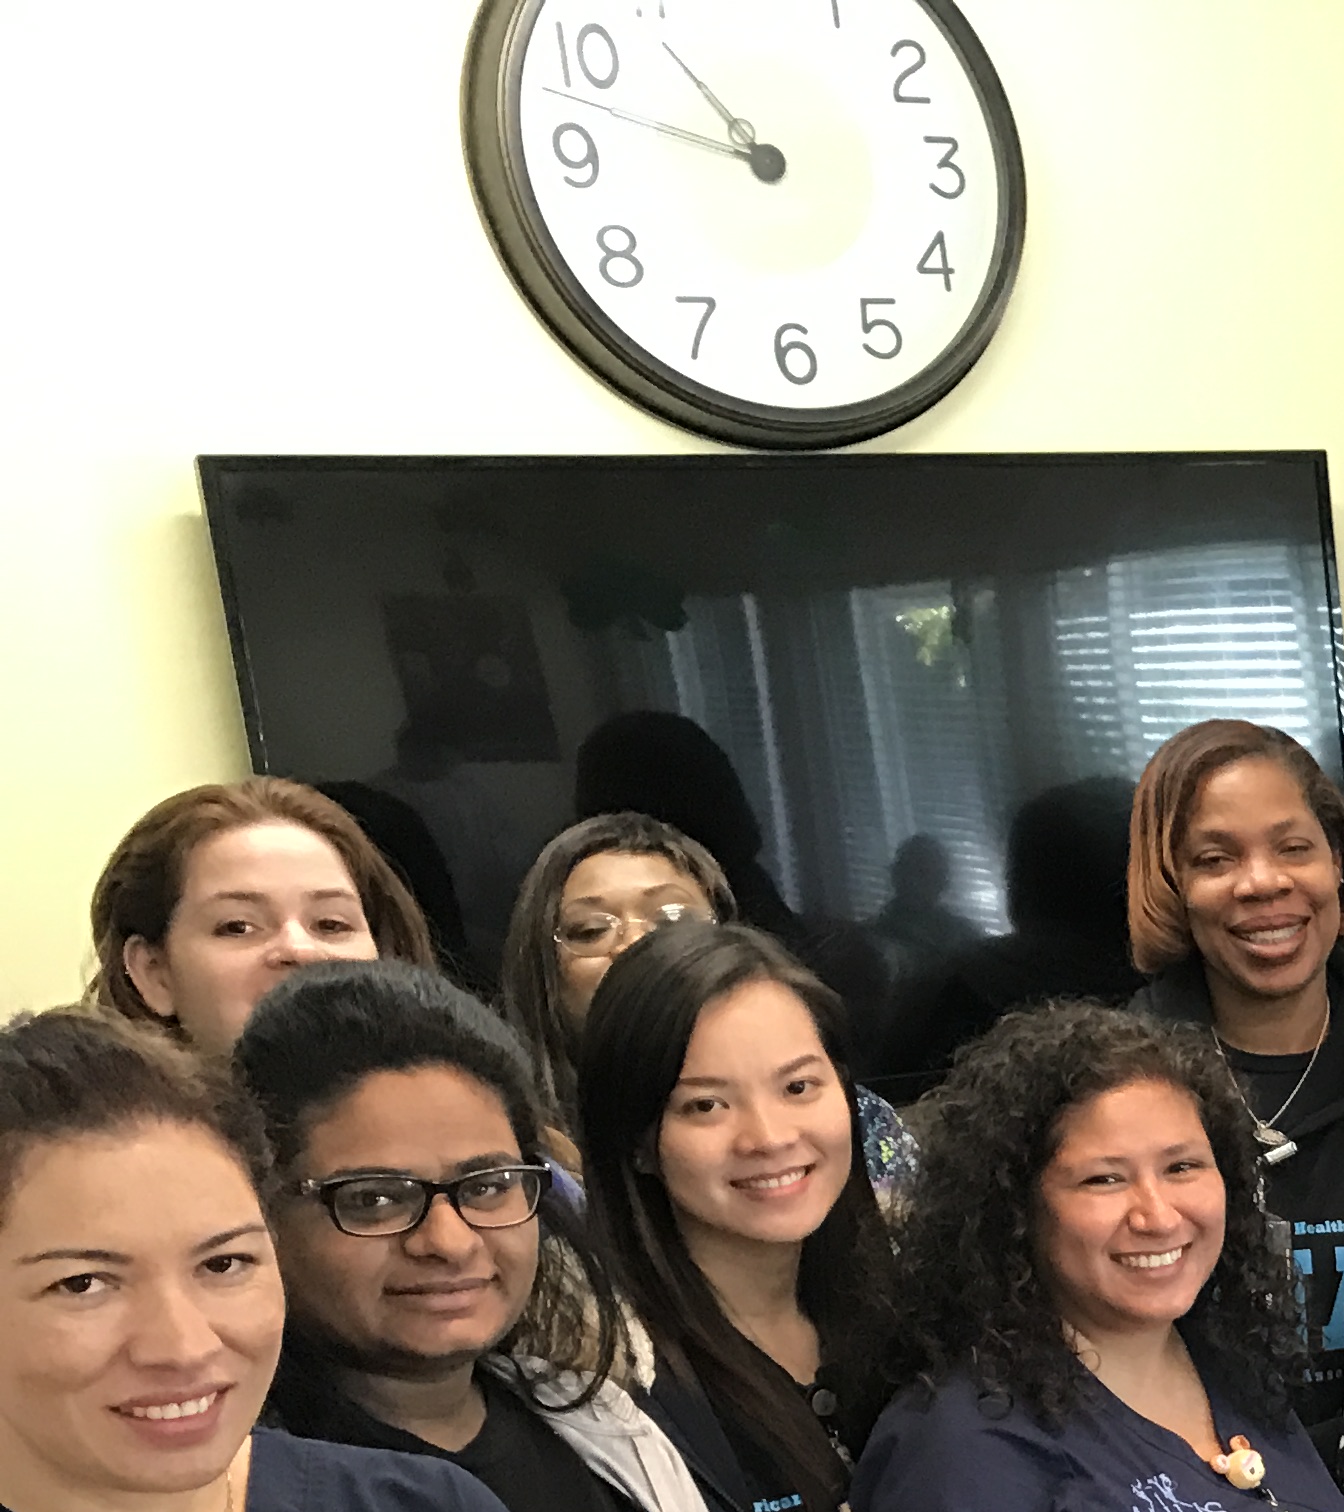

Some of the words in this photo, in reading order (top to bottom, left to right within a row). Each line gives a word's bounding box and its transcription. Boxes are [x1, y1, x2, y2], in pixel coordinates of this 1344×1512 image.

[556, 20, 620, 90] 10
[889, 39, 931, 104] 2
[552, 122, 600, 189] 9
[922, 135, 966, 200] 3
[595, 224, 644, 289] 8
[915, 230, 955, 292] 4
[675, 295, 717, 361] 7
[773, 322, 818, 386] 6
[859, 297, 902, 360] 5
[752, 1493, 803, 1512] rican
